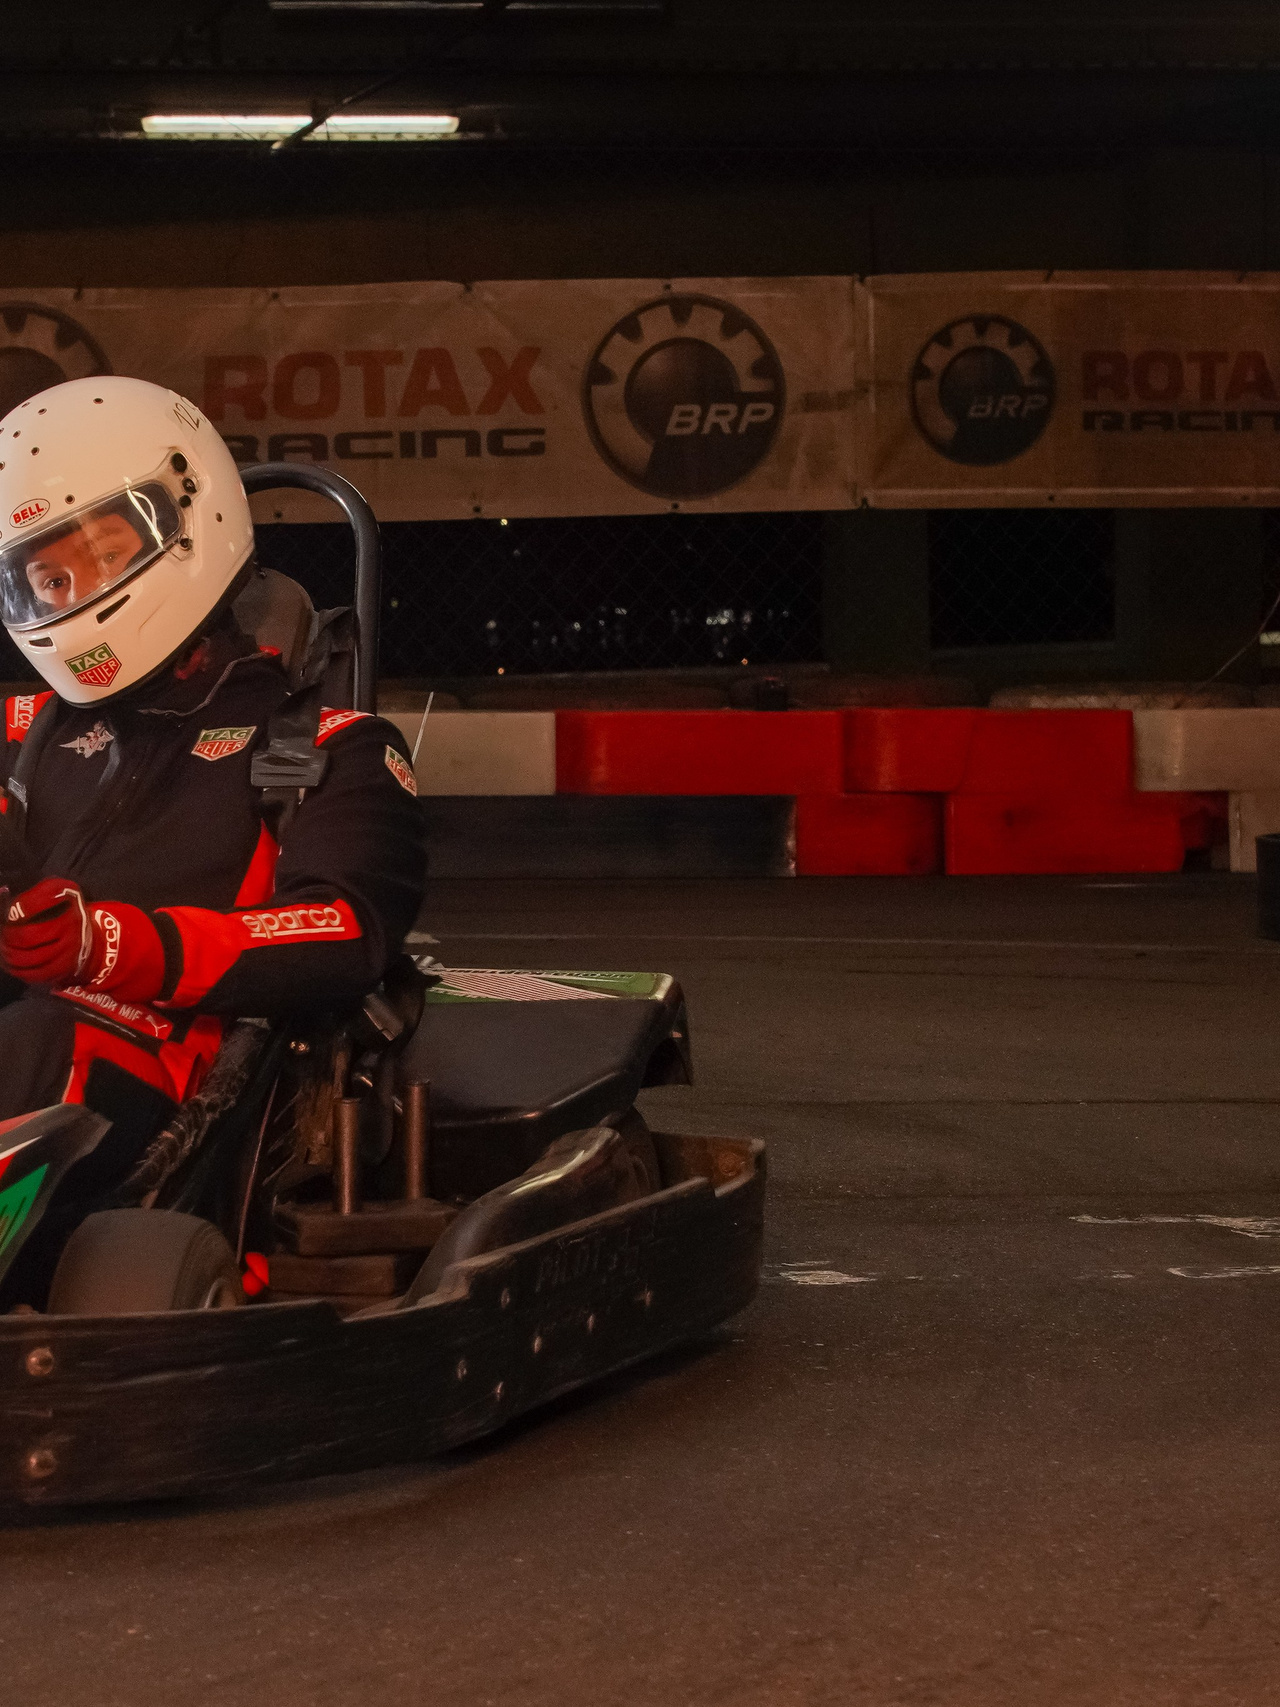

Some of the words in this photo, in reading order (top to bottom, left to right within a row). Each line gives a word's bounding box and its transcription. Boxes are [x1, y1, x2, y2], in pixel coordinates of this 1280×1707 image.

[203, 347, 546, 421] ROTAX
[1082, 350, 1280, 402] ROTA
[665, 402, 775, 436] BRP
[969, 393, 1049, 418] BRP
[1083, 410, 1280, 432] RACIN
[220, 428, 546, 463] RACING
[12, 502, 45, 524] BELL
[71, 648, 110, 671] TAG
[78, 660, 117, 684] HEUER
[14, 695, 36, 730] parco
[197, 741, 244, 757] HEUER
[206, 730, 248, 740] TAG
[242, 907, 342, 939] sparco
[91, 915, 119, 985] parco
